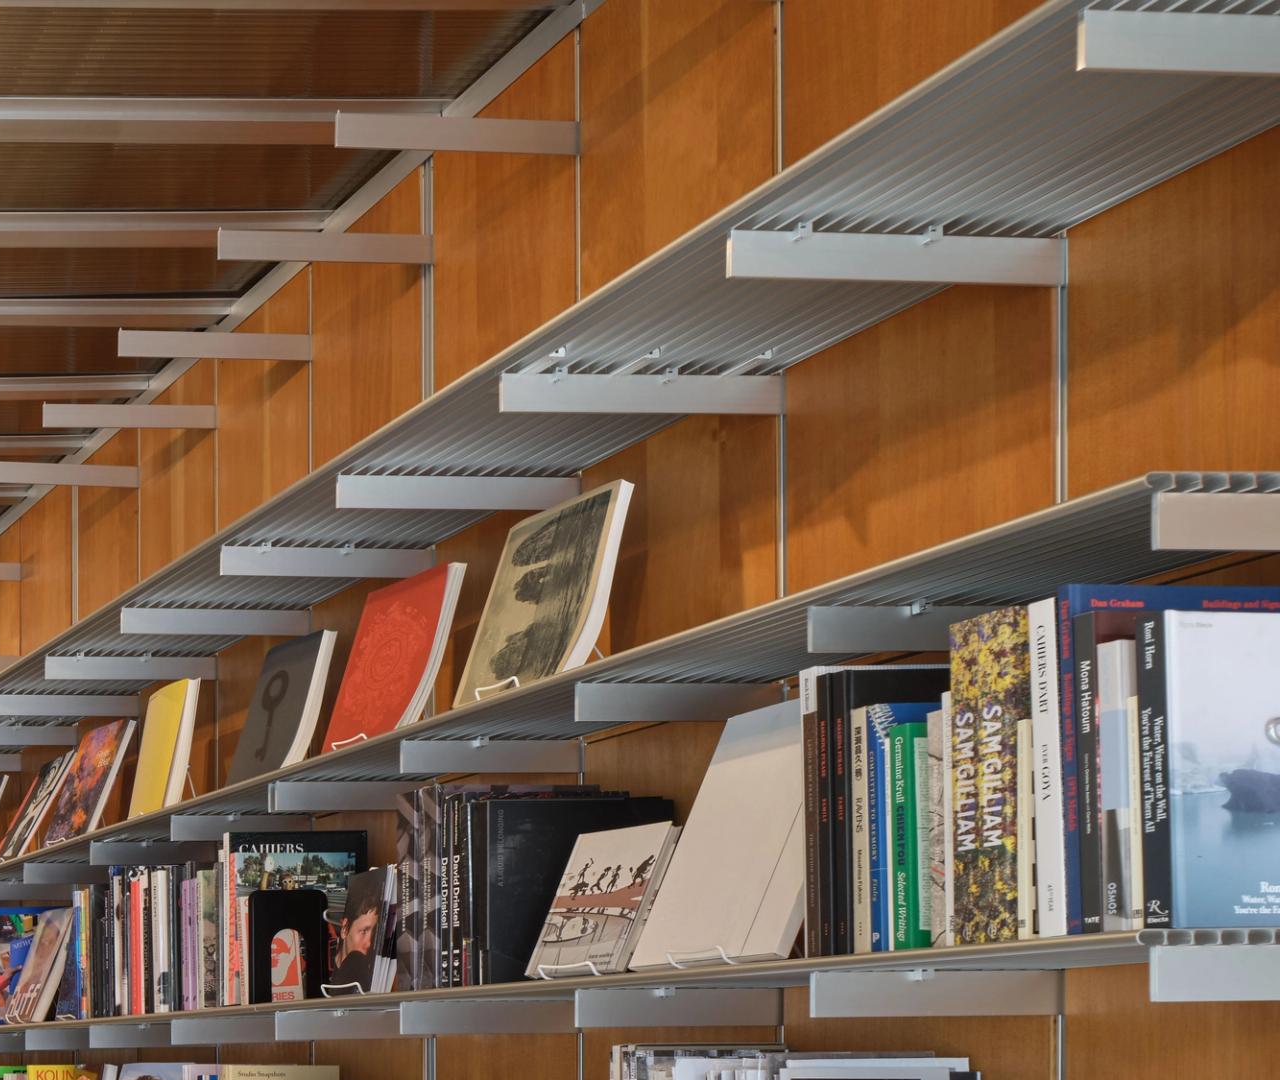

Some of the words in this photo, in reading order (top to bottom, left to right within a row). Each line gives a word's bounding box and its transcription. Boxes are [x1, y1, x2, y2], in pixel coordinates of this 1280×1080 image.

[1091, 600, 1108, 608] Dan
[1110, 600, 1144, 608] Graham
[1202, 601, 1242, 609] Buildings
[1062, 622, 1071, 659] Graham
[1144, 621, 1154, 642] Roni
[1037, 625, 1048, 678] CAHIERS
[1145, 645, 1155, 669] Horn
[1080, 660, 1092, 690] Mona
[1064, 672, 1073, 717] Buildings
[1081, 692, 1093, 734] Hatoum
[1141, 708, 1152, 732] You're
[956, 712, 974, 759] SAM
[982, 705, 1001, 754] SAM
[1143, 734, 1152, 750] the
[1153, 716, 1163, 743] Water,
[895, 737, 904, 780] Germaine
[1143, 752, 1153, 781] Fairest
[1154, 745, 1164, 771] Water
[1041, 766, 1051, 800] GOYA
[1144, 783, 1153, 792] of
[1155, 772, 1163, 782] on
[896, 781, 905, 802] Krull
[982, 758, 1003, 847] GILLIAM
[1156, 785, 1165, 799] the
[855, 797, 863, 832] RAVENS
[870, 809, 876, 819] TO
[956, 764, 975, 851] GILLIAM
[1068, 799, 1077, 830] Models
[1145, 793, 1154, 818] Them
[1156, 800, 1166, 823] Wall,
[897, 805, 905, 840] CHIEN
[1145, 820, 1154, 833] All
[239, 843, 304, 854] CAHIERS
[897, 872, 906, 904] Selected
[1107, 882, 1117, 915] OSMOS
[1242, 895, 1266, 904] Water,
[1084, 916, 1100, 924] TATE
[1234, 906, 1258, 914] You're
[1259, 906, 1271, 914] the
[897, 907, 906, 941] Writings
